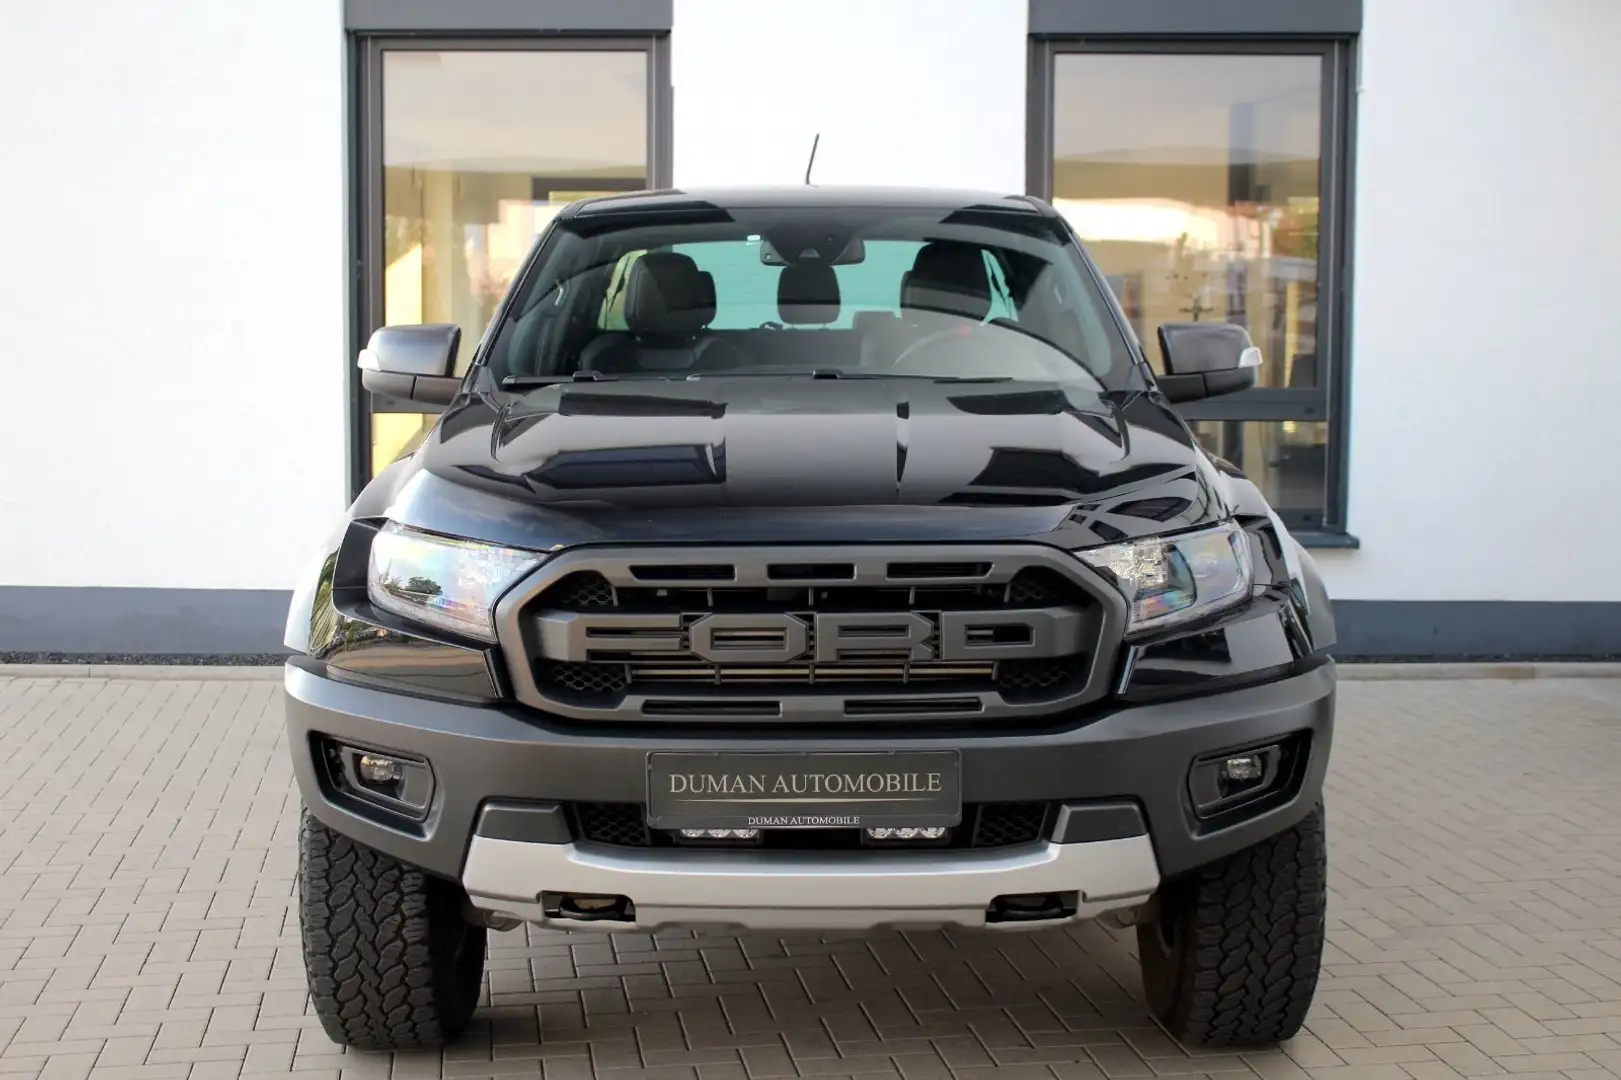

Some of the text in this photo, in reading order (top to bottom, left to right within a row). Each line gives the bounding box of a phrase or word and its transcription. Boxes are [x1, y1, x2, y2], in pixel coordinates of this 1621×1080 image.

[562, 610, 1058, 662] FORD
[669, 772, 942, 793] DUMAN AUTOMOBILE
[748, 816, 860, 825] DUMAN AUTOMOBILE
